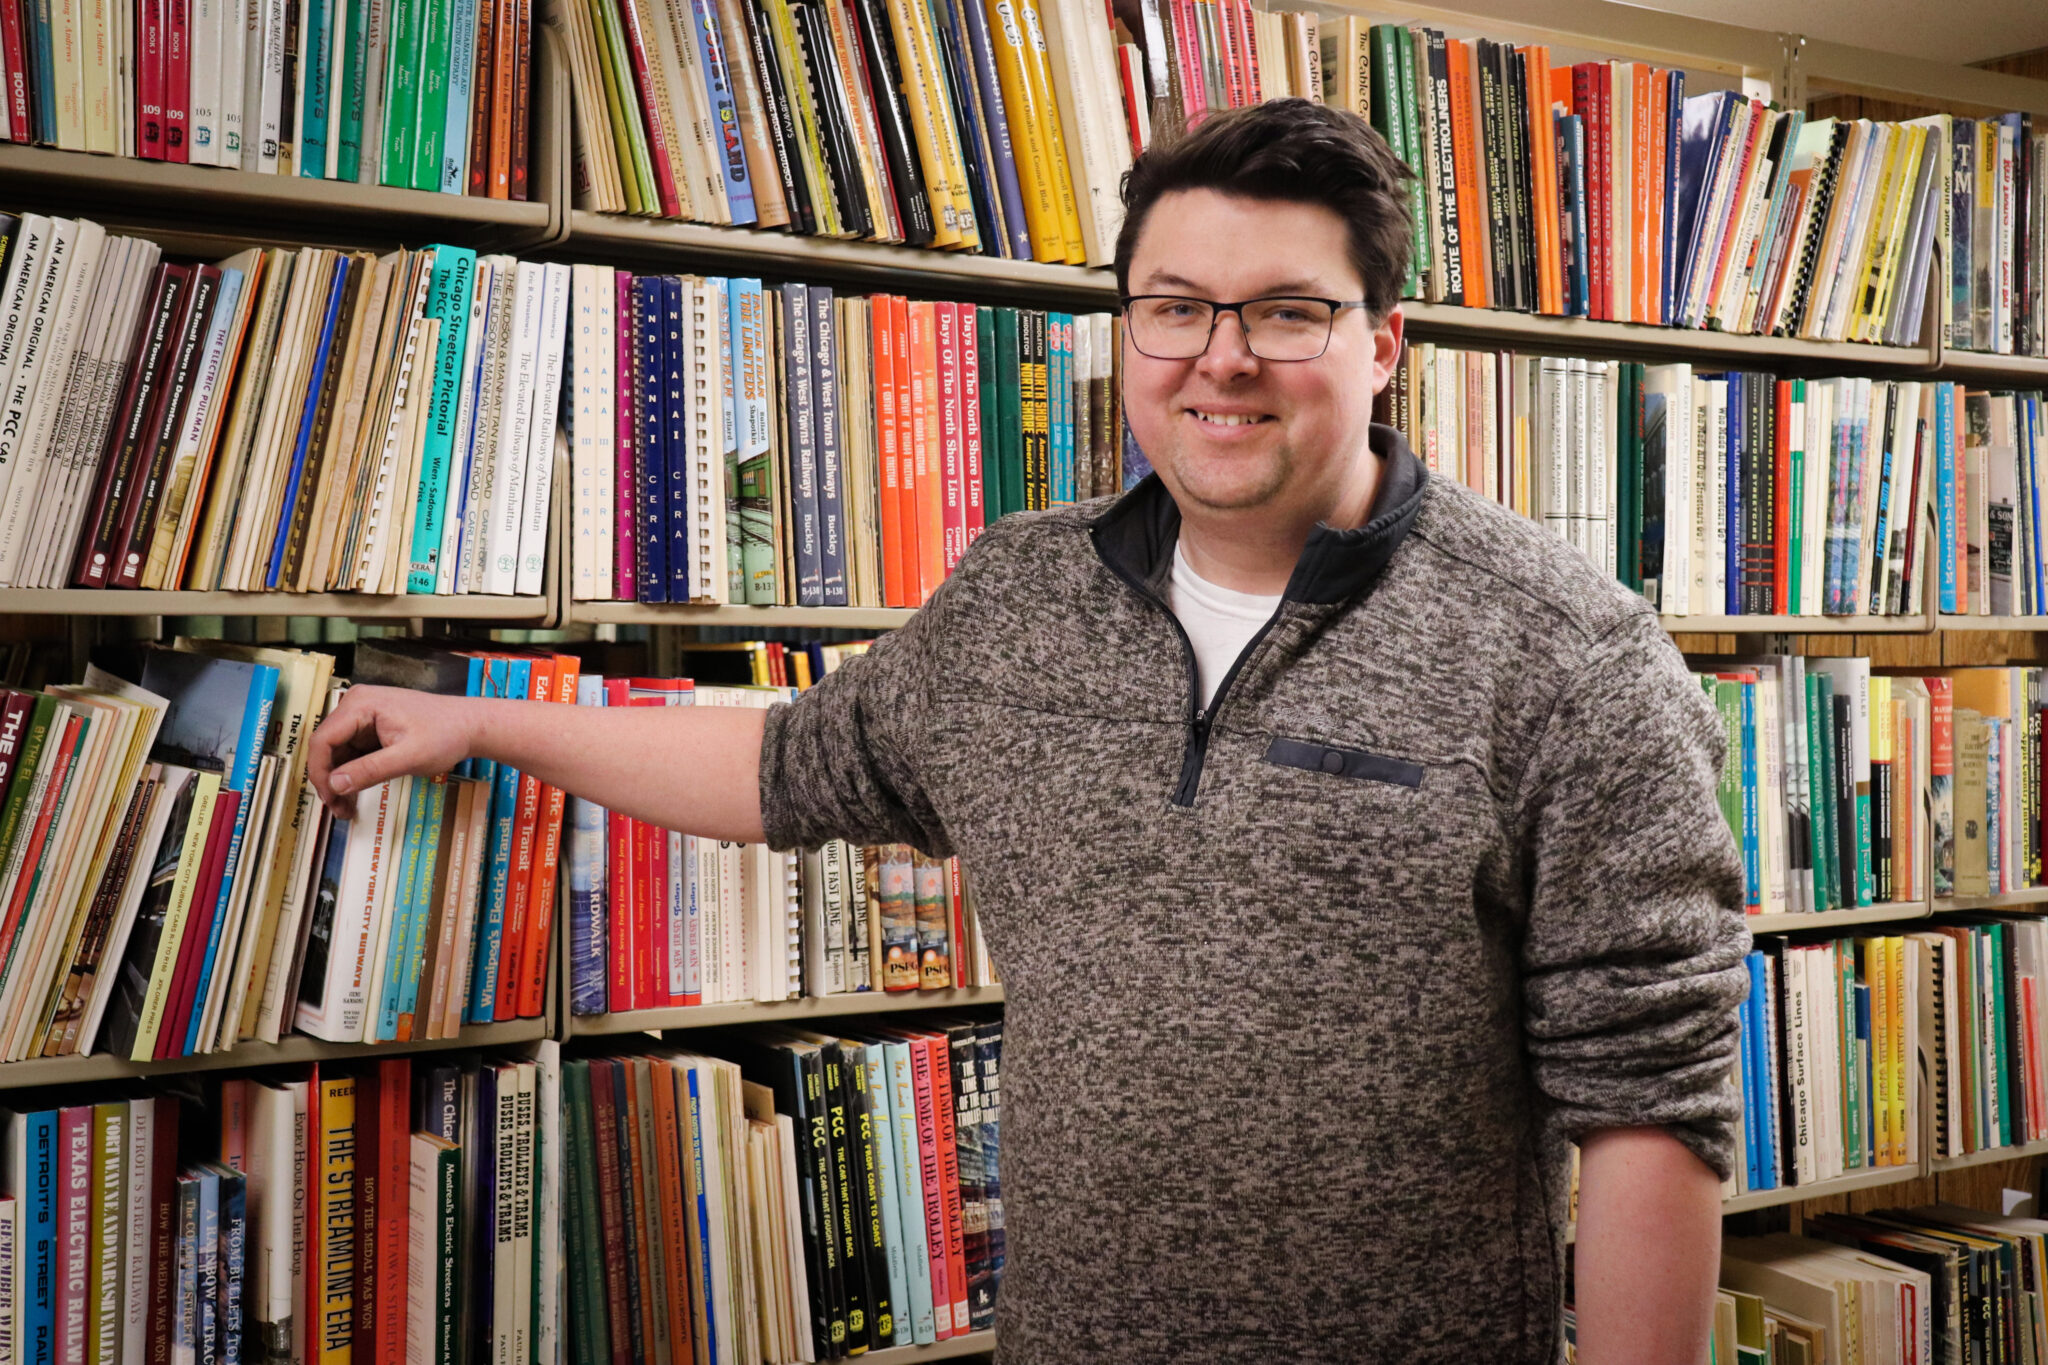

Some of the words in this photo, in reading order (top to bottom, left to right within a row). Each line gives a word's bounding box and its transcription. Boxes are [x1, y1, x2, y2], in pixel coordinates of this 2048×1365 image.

[1307, 27, 1316, 48] The
[1310, 51, 1321, 90] Cable
[143, 105, 161, 115] 109
[166, 109, 184, 120] 109
[267, 123, 276, 132] 94
[779, 95, 795, 139] SUBWAYS
[1748, 113, 1761, 143] Street
[717, 100, 746, 182] ISLAND
[1000, 122, 1012, 159] RIDE
[1029, 137, 1039, 152] and
[1437, 78, 1454, 188] ELECTROLINERS
[1033, 155, 1045, 186] Council
[1445, 193, 1457, 218] THE
[54, 237, 65, 255] AN
[1447, 224, 1458, 243] OF
[38, 257, 62, 315] AMERICAN
[439, 269, 451, 288] The
[450, 257, 469, 312] Chicago
[493, 272, 504, 297] THE
[1448, 246, 1462, 293] ROUTE
[162, 283, 178, 306] From
[435, 291, 447, 314] PCC
[792, 296, 803, 318] The
[155, 308, 174, 344] Small
[487, 299, 501, 350] HUDSON
[792, 319, 806, 365] Chicago
[940, 313, 951, 345] Days
[22, 317, 46, 369] ORIGINAL
[147, 345, 162, 371] Town
[443, 314, 462, 376] Streetcar
[486, 351, 495, 359] &
[622, 289, 631, 418] INDIANA
[648, 295, 658, 423] INDIANA
[942, 349, 954, 368] Of
[143, 372, 154, 382] to
[796, 366, 806, 377] &
[944, 370, 955, 394] The
[1020, 363, 1034, 399] NORTH
[1400, 368, 1408, 390] OLD
[13, 384, 27, 406] THE
[436, 378, 455, 437] Pictorial
[477, 362, 495, 440] MANHATTAN
[797, 379, 808, 407] West
[3, 409, 22, 438] PCC
[129, 384, 151, 440] Downtown
[799, 409, 810, 446] Towns
[945, 398, 957, 436] North
[1022, 400, 1035, 435] SHORE
[470, 441, 486, 501] RAILROAD
[800, 449, 814, 498] Railways
[946, 439, 957, 476] Shore
[623, 470, 632, 538] CERA
[650, 476, 658, 543] CERA
[947, 479, 958, 507] Line
[0, 710, 23, 757] THE
[247, 699, 272, 774] Saskatoon's
[288, 714, 302, 735] The
[196, 794, 209, 826] GRELLER
[237, 777, 255, 830] Electric
[187, 849, 196, 866] YORK
[191, 832, 200, 847] NEW
[223, 835, 242, 878] Transit
[495, 815, 512, 866] Transit
[518, 822, 535, 872] Transit
[544, 818, 561, 869] Transit
[183, 869, 191, 884] CITY
[828, 871, 840, 896] FAST
[176, 884, 187, 912] SUBWAY
[489, 866, 507, 925] Electric
[829, 900, 841, 927] LINE
[171, 914, 180, 932] CARS
[481, 927, 500, 1008] Winnipeg's
[146, 1012, 156, 1034] PRESS
[1793, 990, 1803, 1028] Lines
[1796, 1033, 1807, 1086] Surface
[329, 1086, 355, 1097] REED
[811, 1115, 826, 1149] PCC
[830, 1105, 845, 1139] PCC
[1796, 1090, 1809, 1146] Chicago
[71, 1123, 88, 1189] TEXAS
[328, 1123, 355, 1165] THE
[38, 1125, 50, 1223] DETROIT'S
[817, 1157, 825, 1173] THE
[819, 1174, 827, 1190] CAR
[444, 1163, 454, 1215] Montreal's
[821, 1191, 829, 1212] THAT
[68, 1196, 87, 1292] ELECTRIC
[326, 1167, 355, 1305] STREAMLINE
[444, 1217, 455, 1254] Electric
[823, 1214, 833, 1245] FOUGHT
[37, 1240, 48, 1309] STREET
[827, 1247, 835, 1268] BACK
[444, 1257, 455, 1308] Streetcars
[1983, 1297, 1991, 1321] PCC
[326, 1314, 353, 1352] ERA
